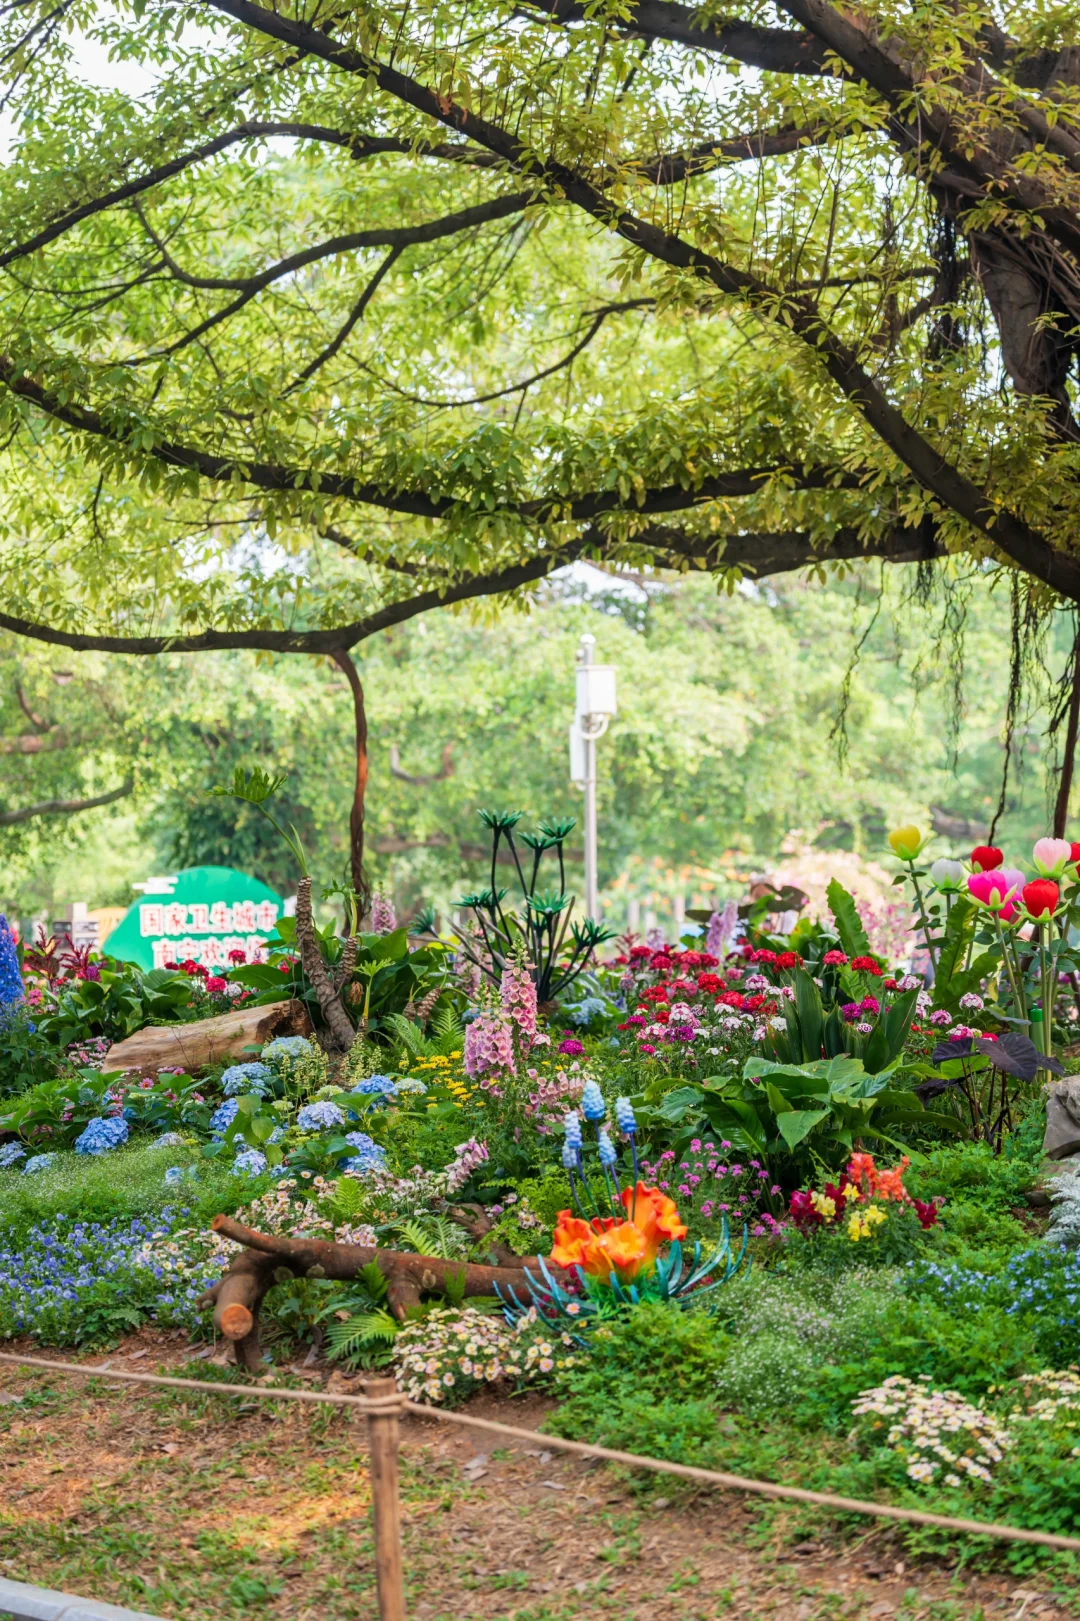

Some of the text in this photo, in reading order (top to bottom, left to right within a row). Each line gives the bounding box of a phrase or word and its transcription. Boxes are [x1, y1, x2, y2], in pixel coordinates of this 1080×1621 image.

[140, 901, 278, 936] 国家卫生城市
